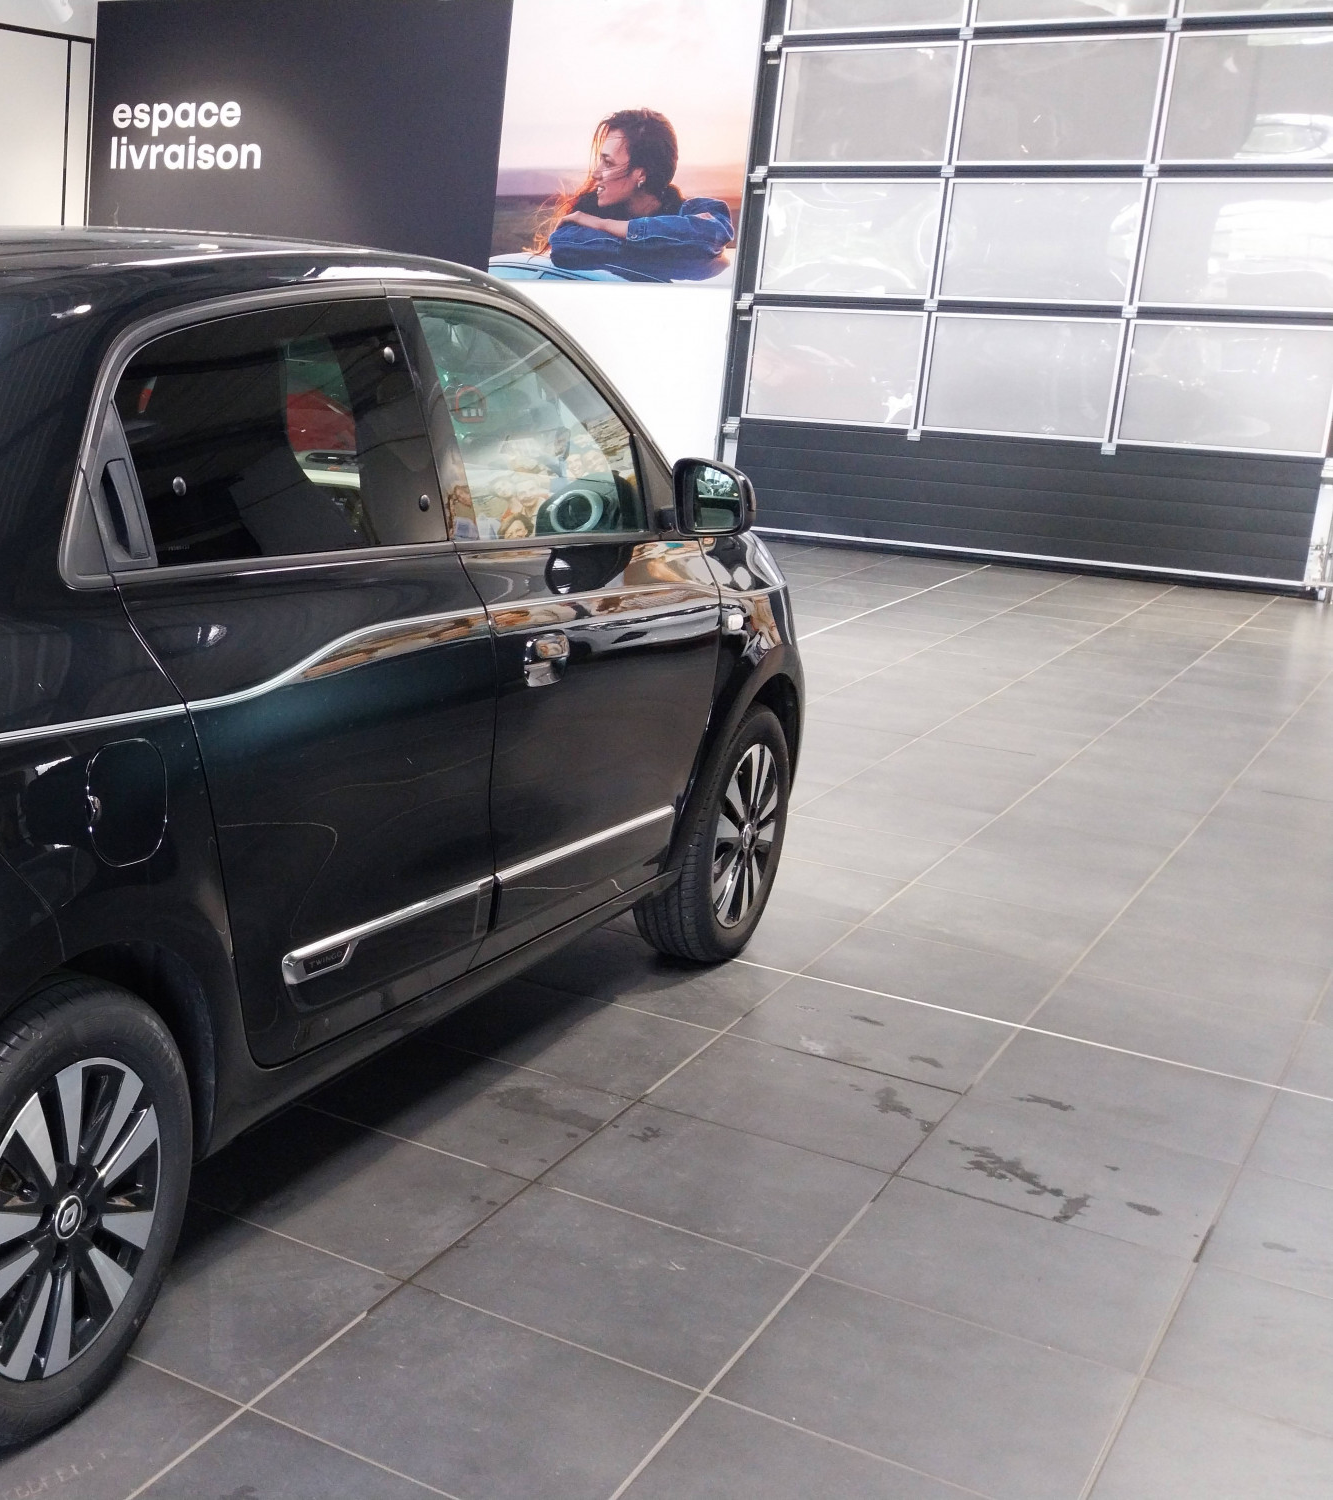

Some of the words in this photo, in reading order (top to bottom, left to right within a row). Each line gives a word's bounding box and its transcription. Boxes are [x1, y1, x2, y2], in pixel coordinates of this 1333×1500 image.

[112, 101, 242, 136] espace
[110, 135, 262, 170] livraison
[309, 950, 343, 969] TWINGO
